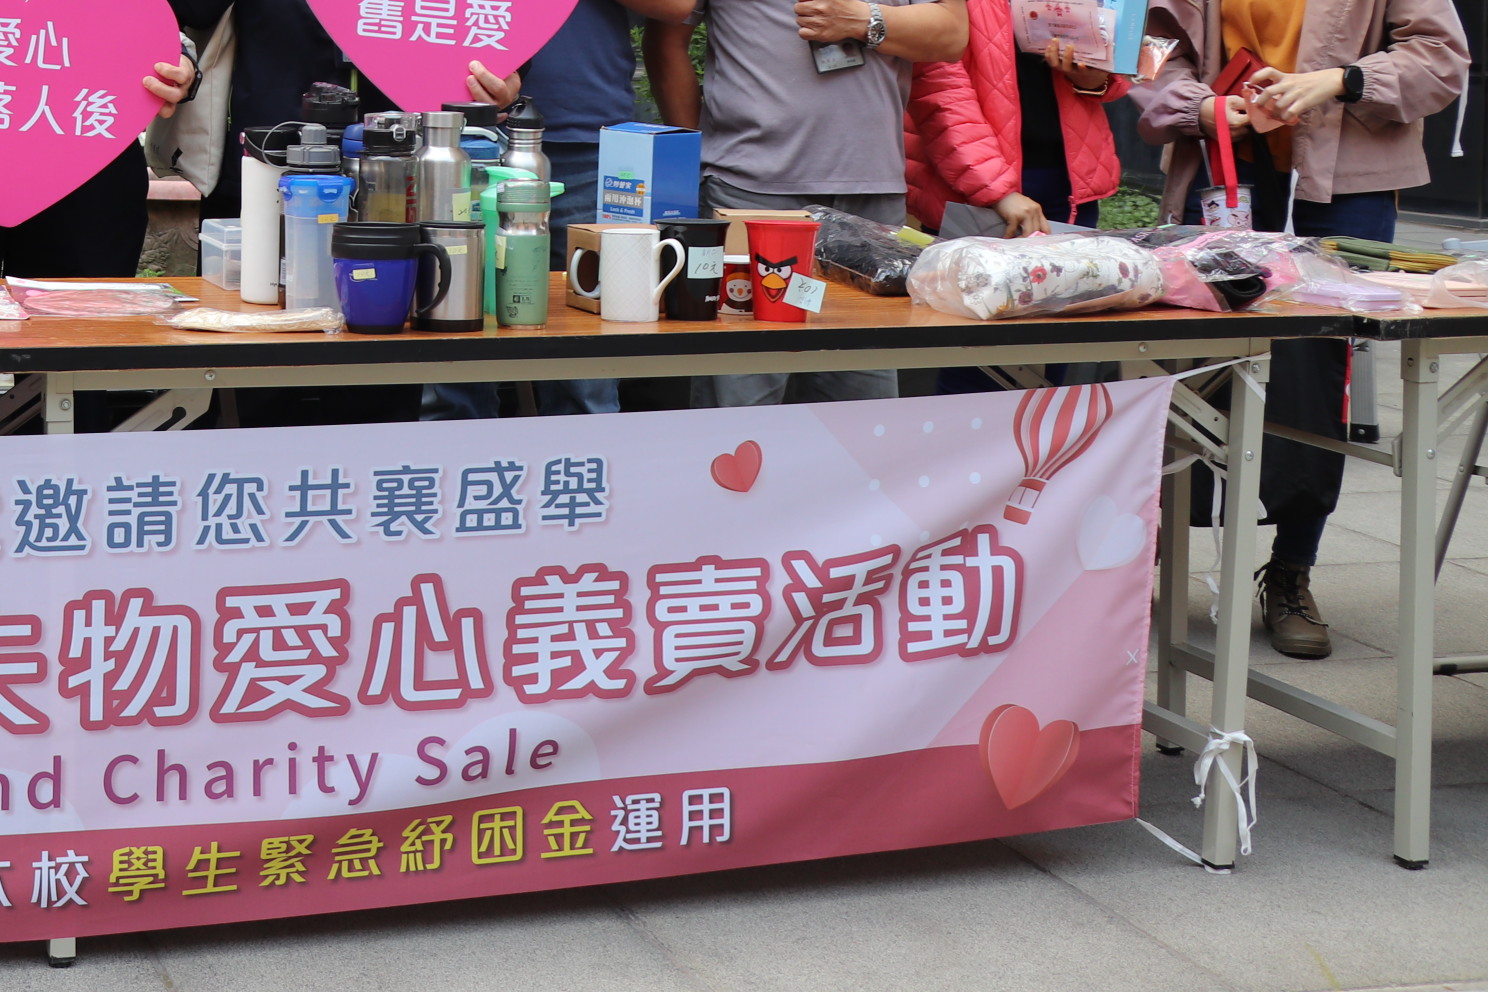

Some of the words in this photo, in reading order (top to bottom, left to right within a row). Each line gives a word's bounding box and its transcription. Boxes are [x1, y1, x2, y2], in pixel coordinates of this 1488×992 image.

[694, 260, 719, 275] 10元
[103, 742, 379, 807] Charity
[415, 728, 560, 787] Sale
